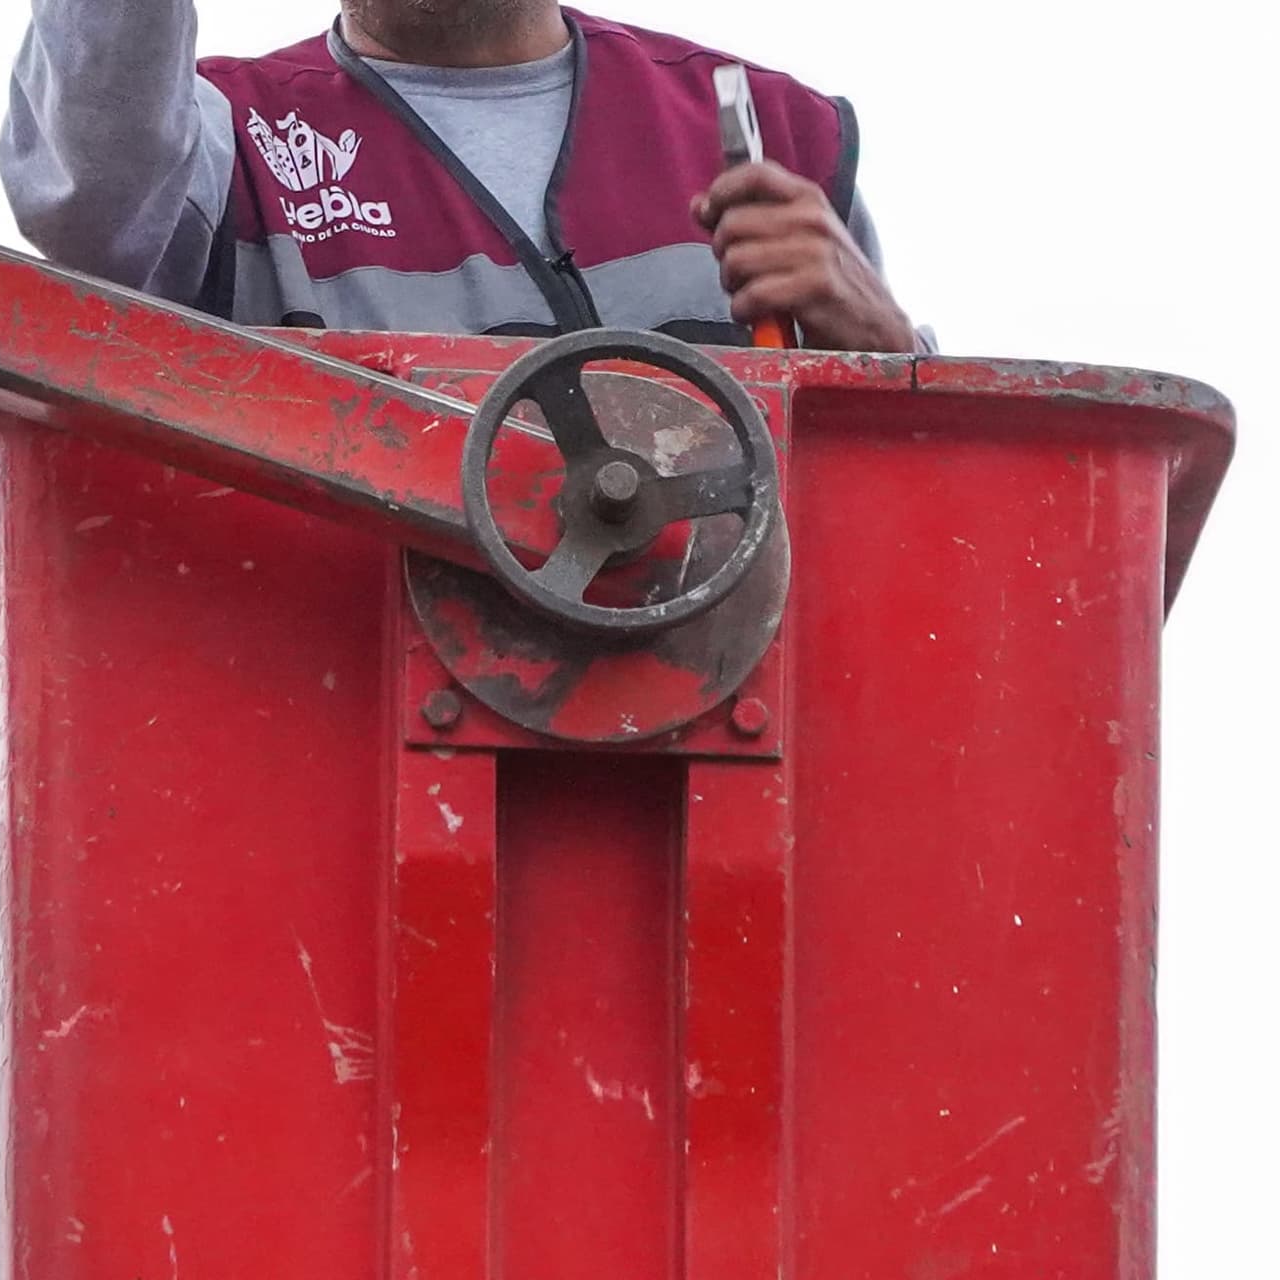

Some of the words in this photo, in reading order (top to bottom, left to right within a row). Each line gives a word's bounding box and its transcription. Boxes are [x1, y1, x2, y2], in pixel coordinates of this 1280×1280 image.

[318, 228, 333, 240] DE
[333, 222, 350, 233] LA
[351, 222, 397, 238] CIUDAD
